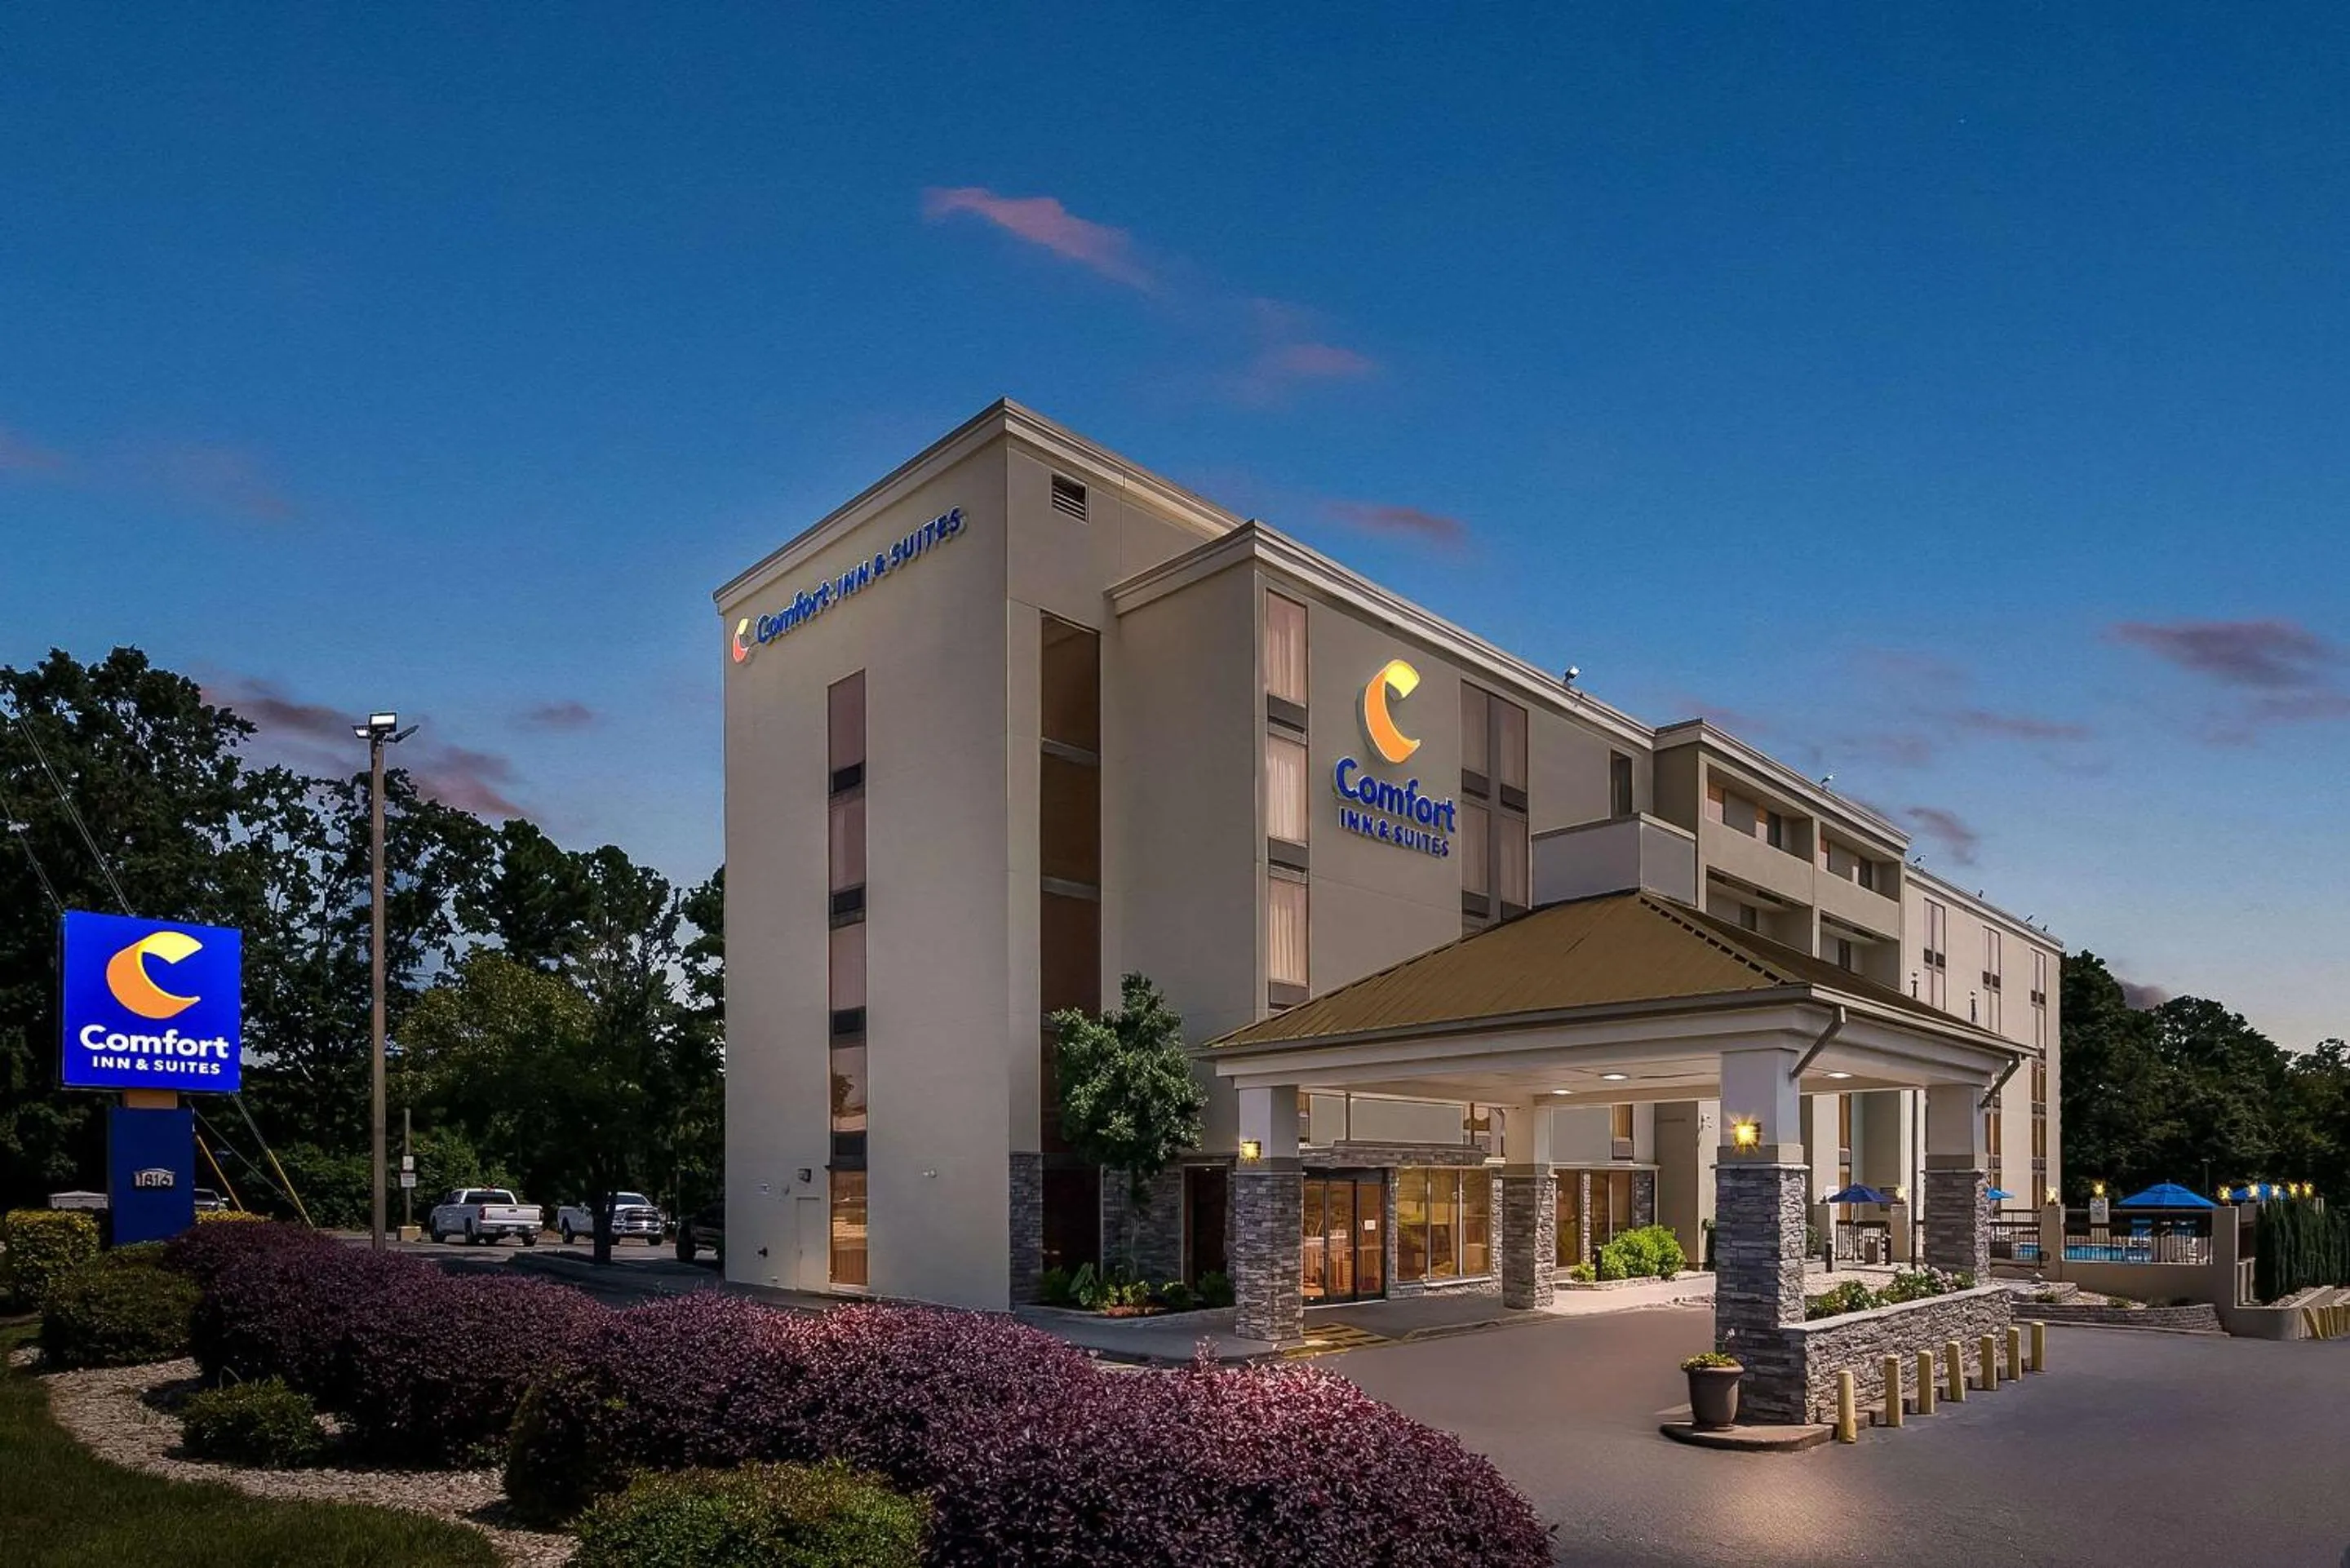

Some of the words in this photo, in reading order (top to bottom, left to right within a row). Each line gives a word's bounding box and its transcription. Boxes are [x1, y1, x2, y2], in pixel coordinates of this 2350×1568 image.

[755, 580, 830, 644] Comfort
[836, 560, 869, 597] INN
[874, 552, 887, 576] &
[889, 506, 964, 566] SUITES
[1335, 756, 1456, 834] Comfort
[1339, 807, 1375, 836] INN
[1378, 818, 1389, 839] &
[1394, 825, 1450, 857] SUITES
[79, 1024, 229, 1059] Comfort
[92, 1056, 131, 1070] INN
[135, 1058, 149, 1071] &
[153, 1060, 220, 1074] SUITES
